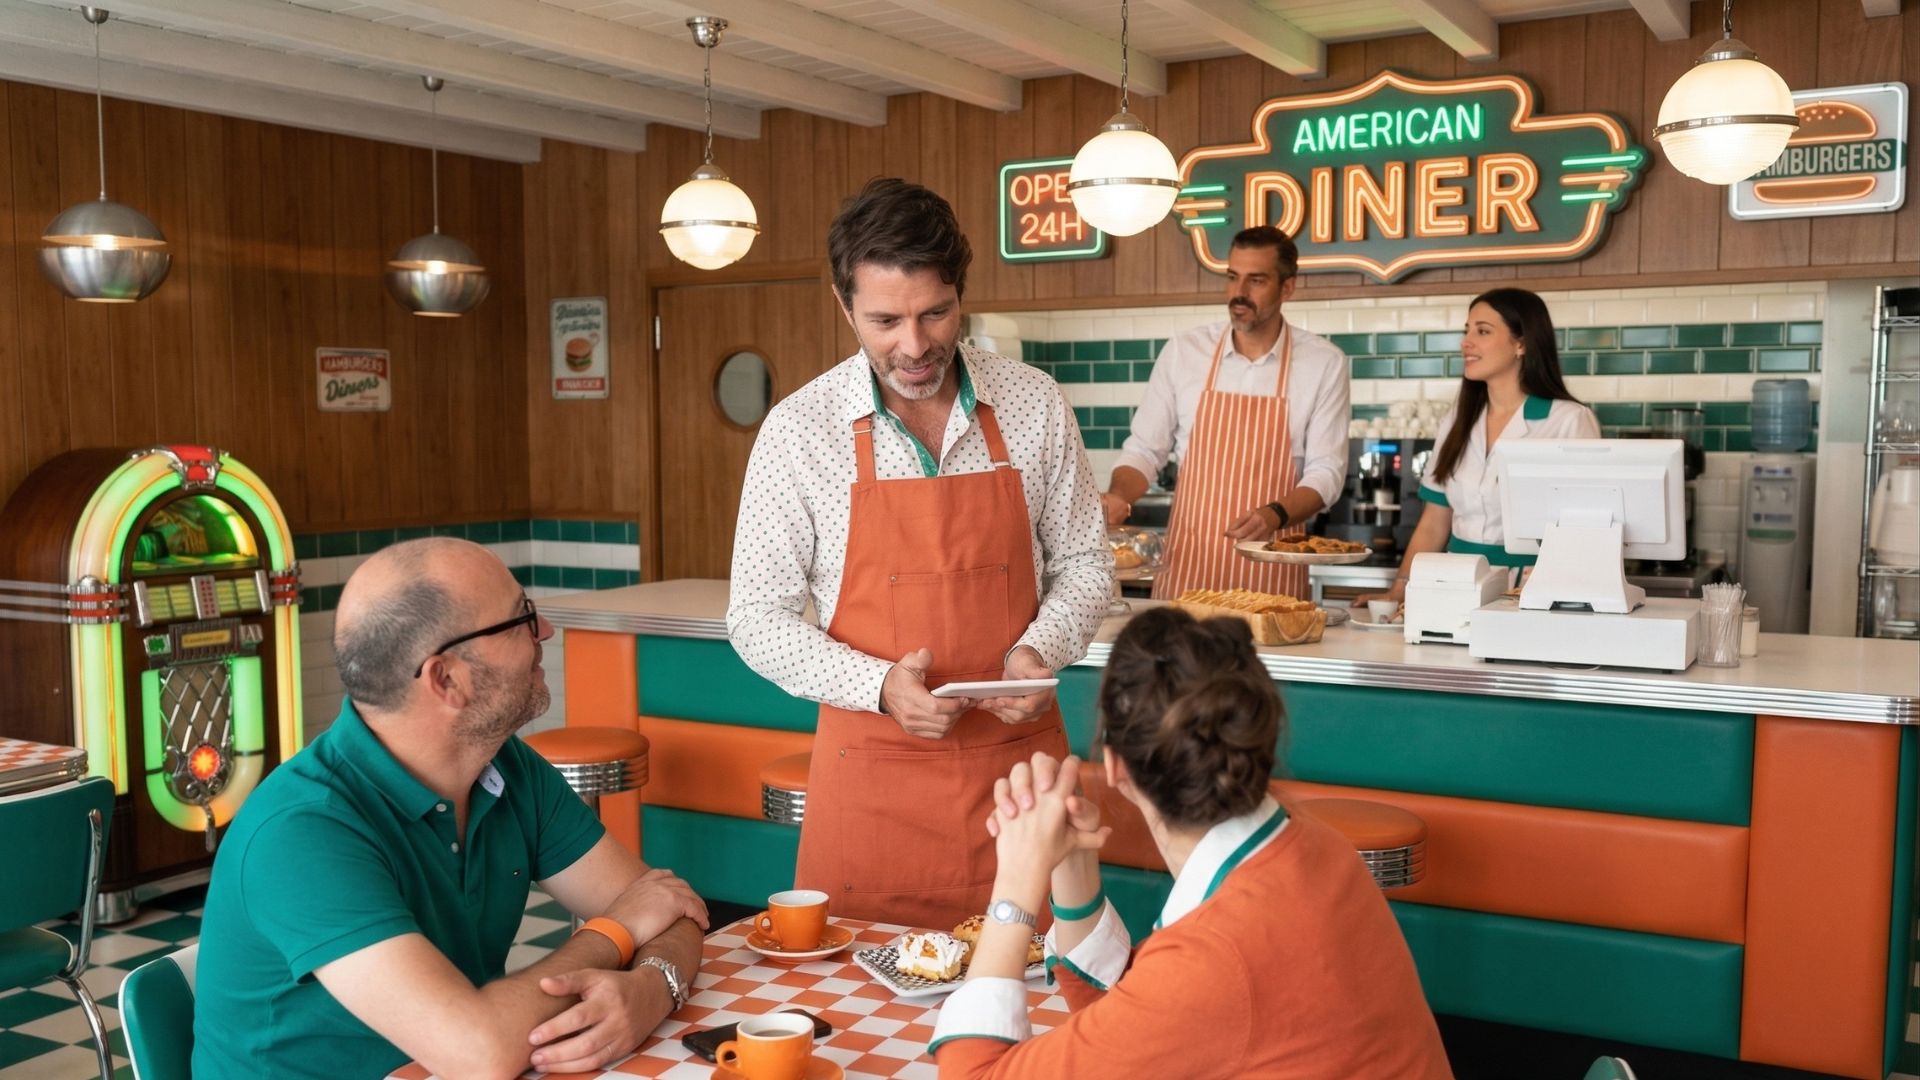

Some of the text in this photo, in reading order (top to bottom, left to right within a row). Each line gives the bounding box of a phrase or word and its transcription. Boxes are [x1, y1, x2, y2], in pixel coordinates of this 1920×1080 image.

[1293, 103, 1482, 154] AMERICAN
[1756, 141, 1892, 178] MBURGERS
[1010, 172, 1073, 206] OPE
[1245, 152, 1540, 243] DINER
[1020, 211, 1082, 244] 24H
